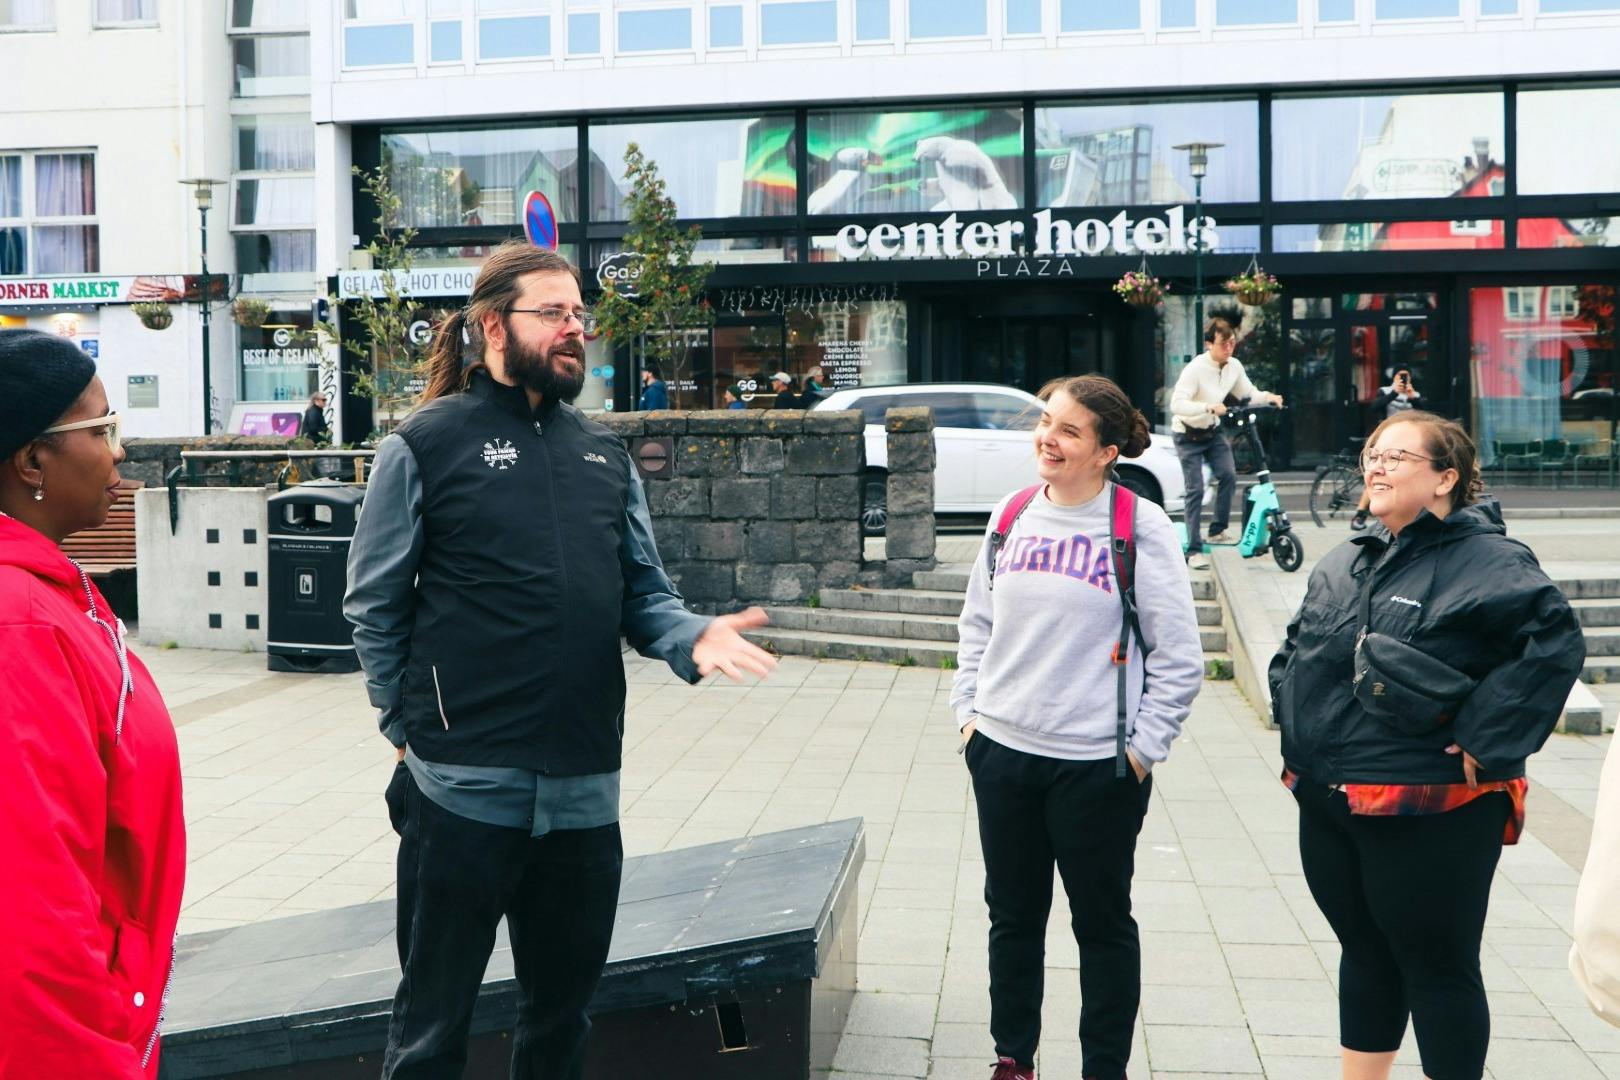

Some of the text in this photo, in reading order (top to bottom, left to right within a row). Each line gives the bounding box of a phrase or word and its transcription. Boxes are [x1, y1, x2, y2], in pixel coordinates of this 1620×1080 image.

[835, 205, 1219, 258] center hotels
[977, 259, 1075, 277] PLAZA
[53, 281, 119, 298] MARKET
[411, 273, 439, 290] HOT
[243, 349, 267, 365] BEST
[268, 349, 282, 364] OF
